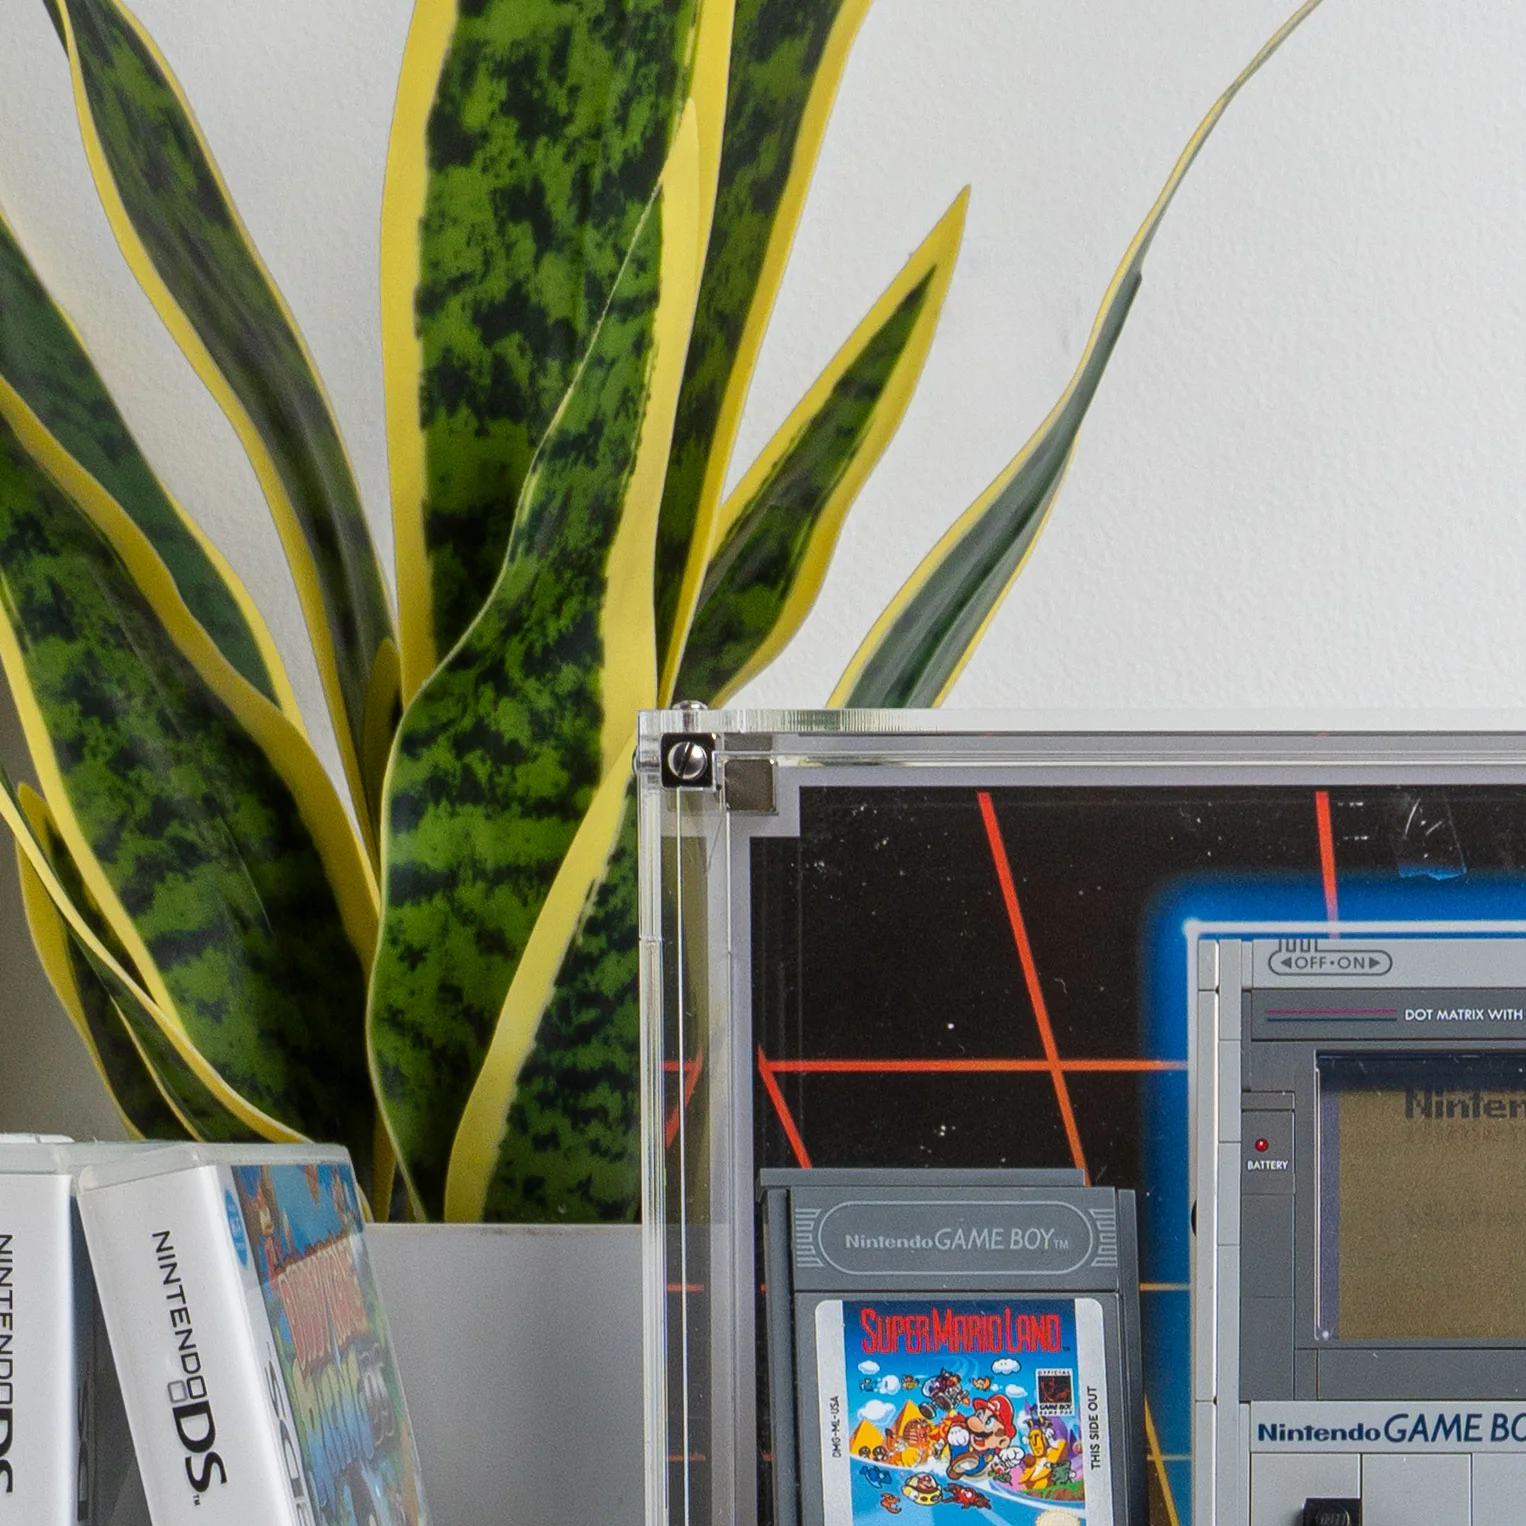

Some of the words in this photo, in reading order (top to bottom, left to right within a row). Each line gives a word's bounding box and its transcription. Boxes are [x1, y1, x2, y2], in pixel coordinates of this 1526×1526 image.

[1404, 1008, 1433, 1021] DOT
[1436, 1008, 1486, 1021] MATRIX
[1488, 1008, 1524, 1021] WITH
[1247, 1159, 1288, 1171] BATTERY
[845, 1233, 933, 1249] Nintendo
[935, 1227, 1003, 1250] GAME
[152, 1230, 207, 1400] NINTENDO
[860, 1307, 930, 1354] SUPER
[930, 1307, 1002, 1353] MARIO
[1087, 1385, 1098, 1412] OUT
[830, 1396, 842, 1458] DMG-ML-USA
[1089, 1414, 1100, 1440] SIDE
[1257, 1423, 1381, 1443] Nintendo
[1383, 1412, 1484, 1443] GAME
[1090, 1443, 1101, 1470] THIS
